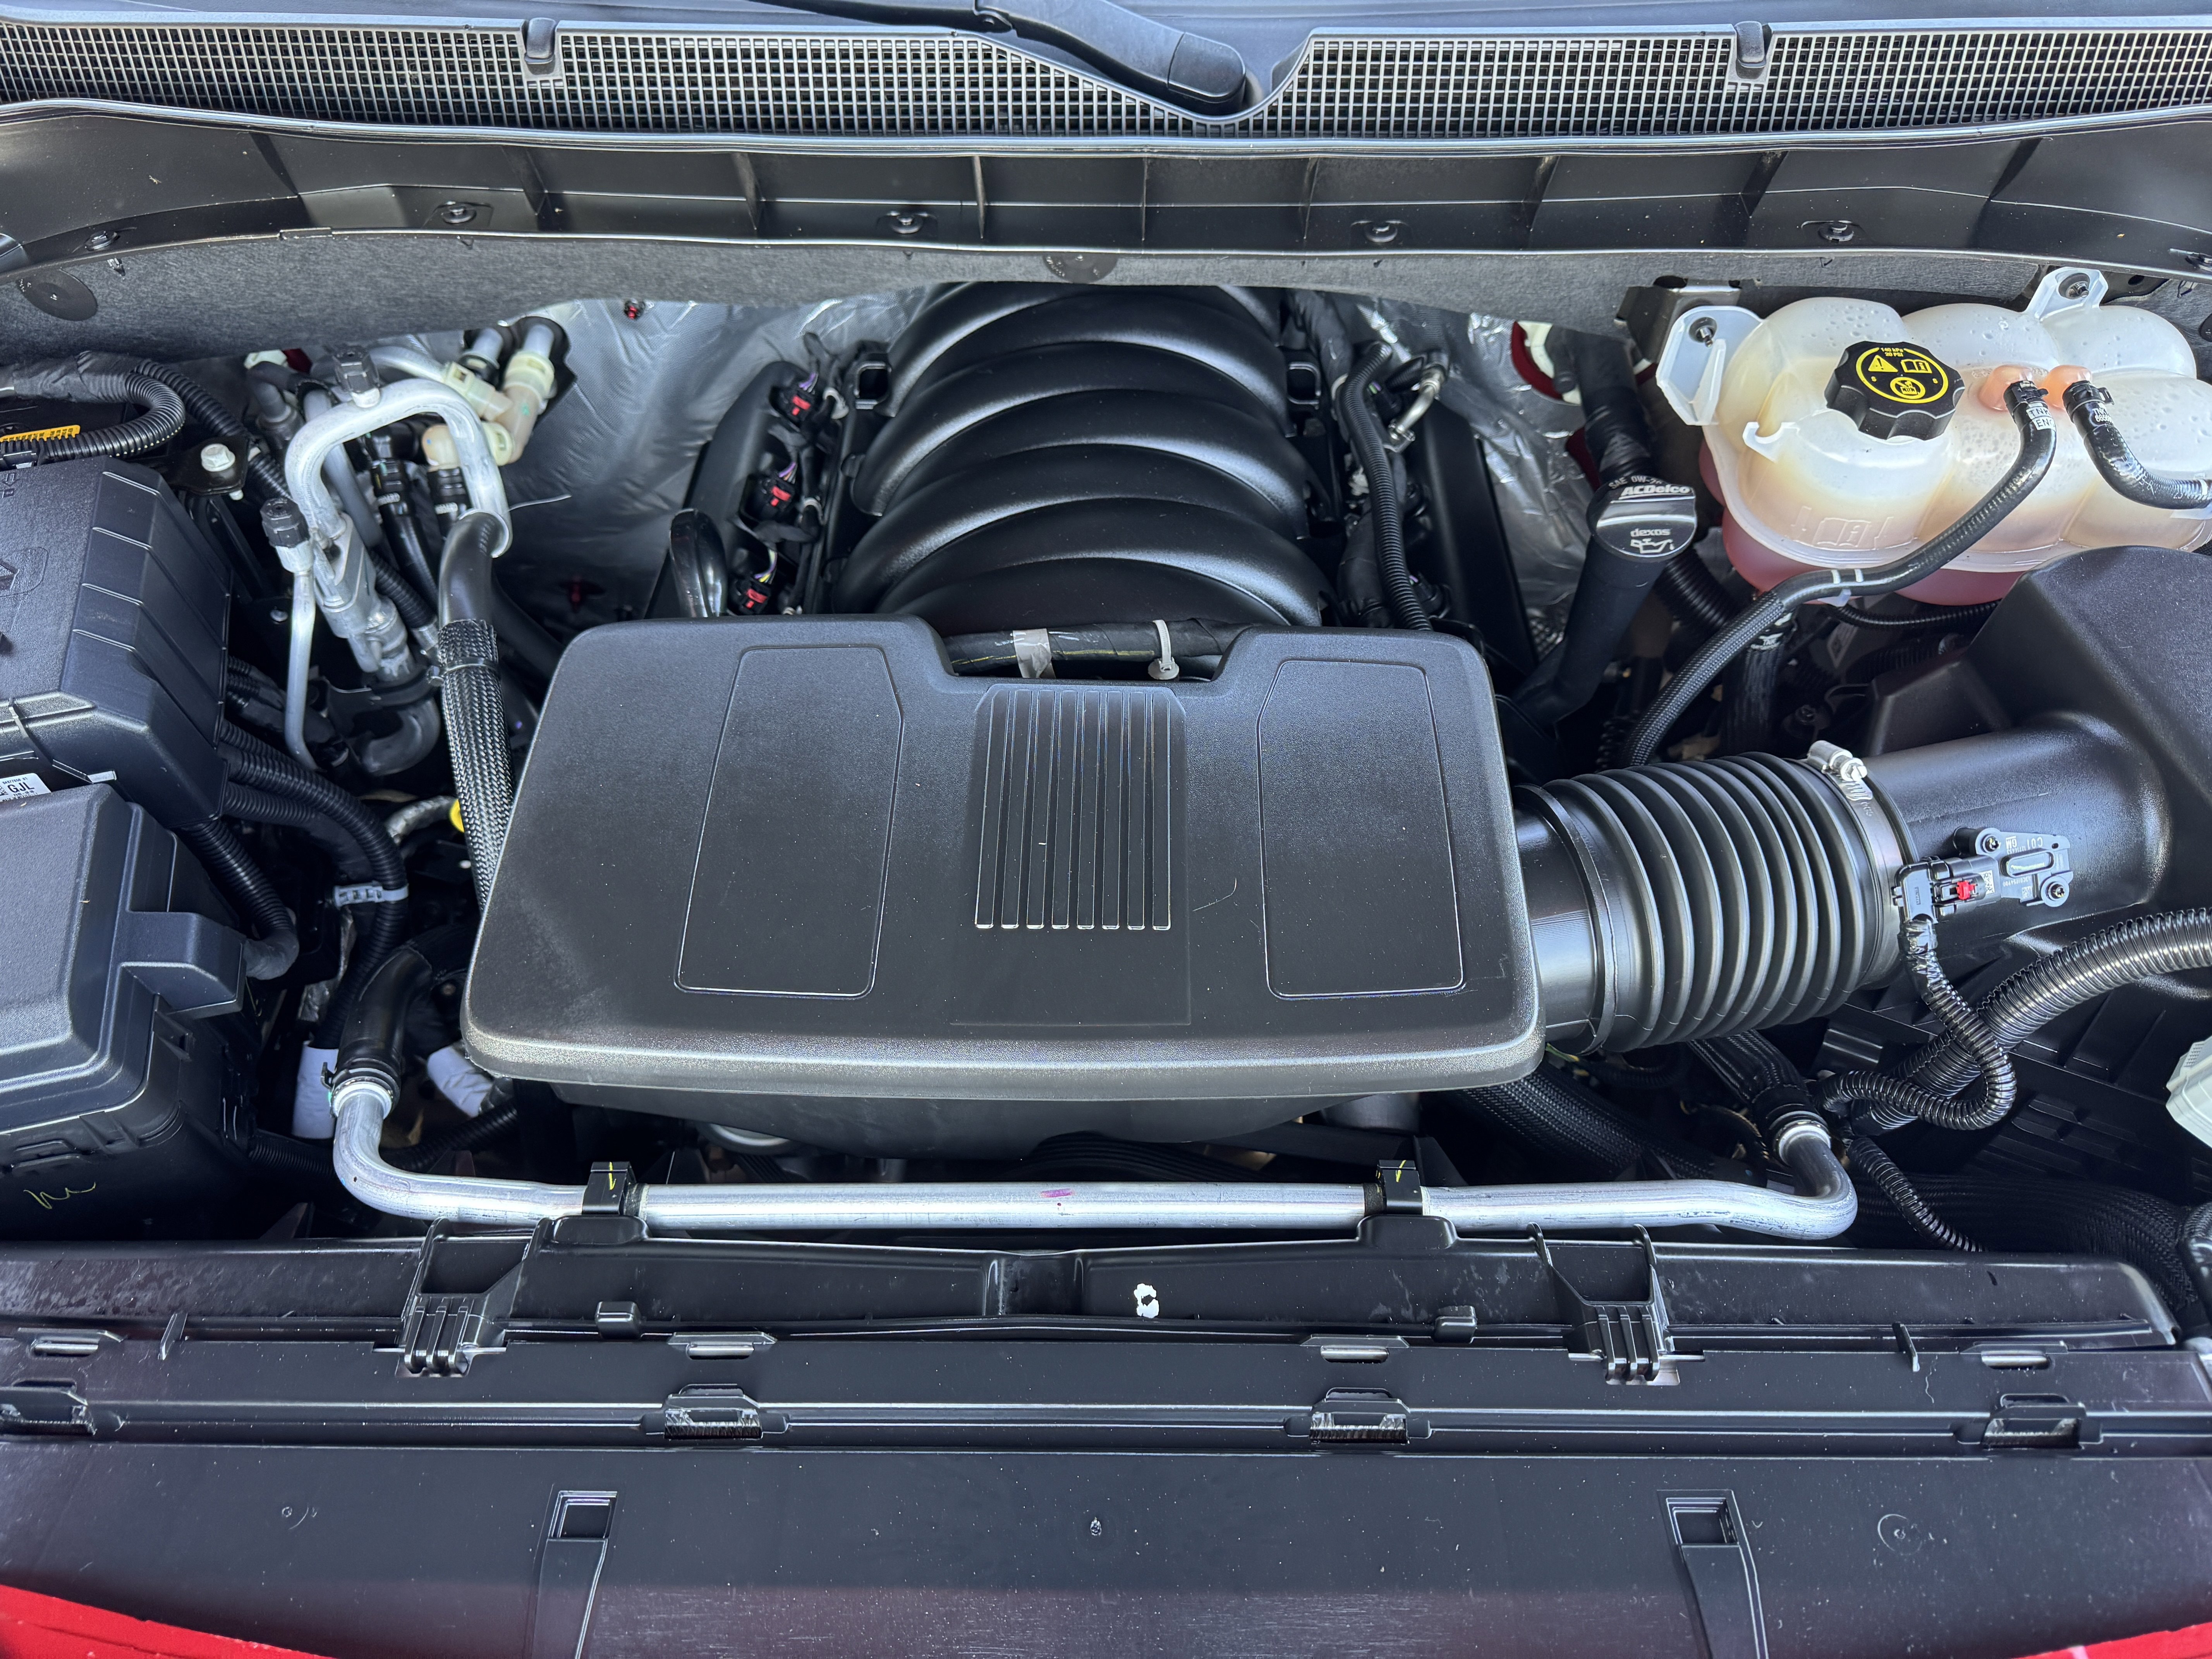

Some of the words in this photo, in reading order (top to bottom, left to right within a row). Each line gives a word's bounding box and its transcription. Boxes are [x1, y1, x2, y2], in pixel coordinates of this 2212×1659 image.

[1609, 477, 1628, 489] SAE
[1621, 484, 1691, 496] ACDelco
[1630, 528, 1672, 537] dexos
[7, 782, 35, 793] GJL
[2006, 838, 2017, 849] GM
[2027, 836, 2043, 850] C01
